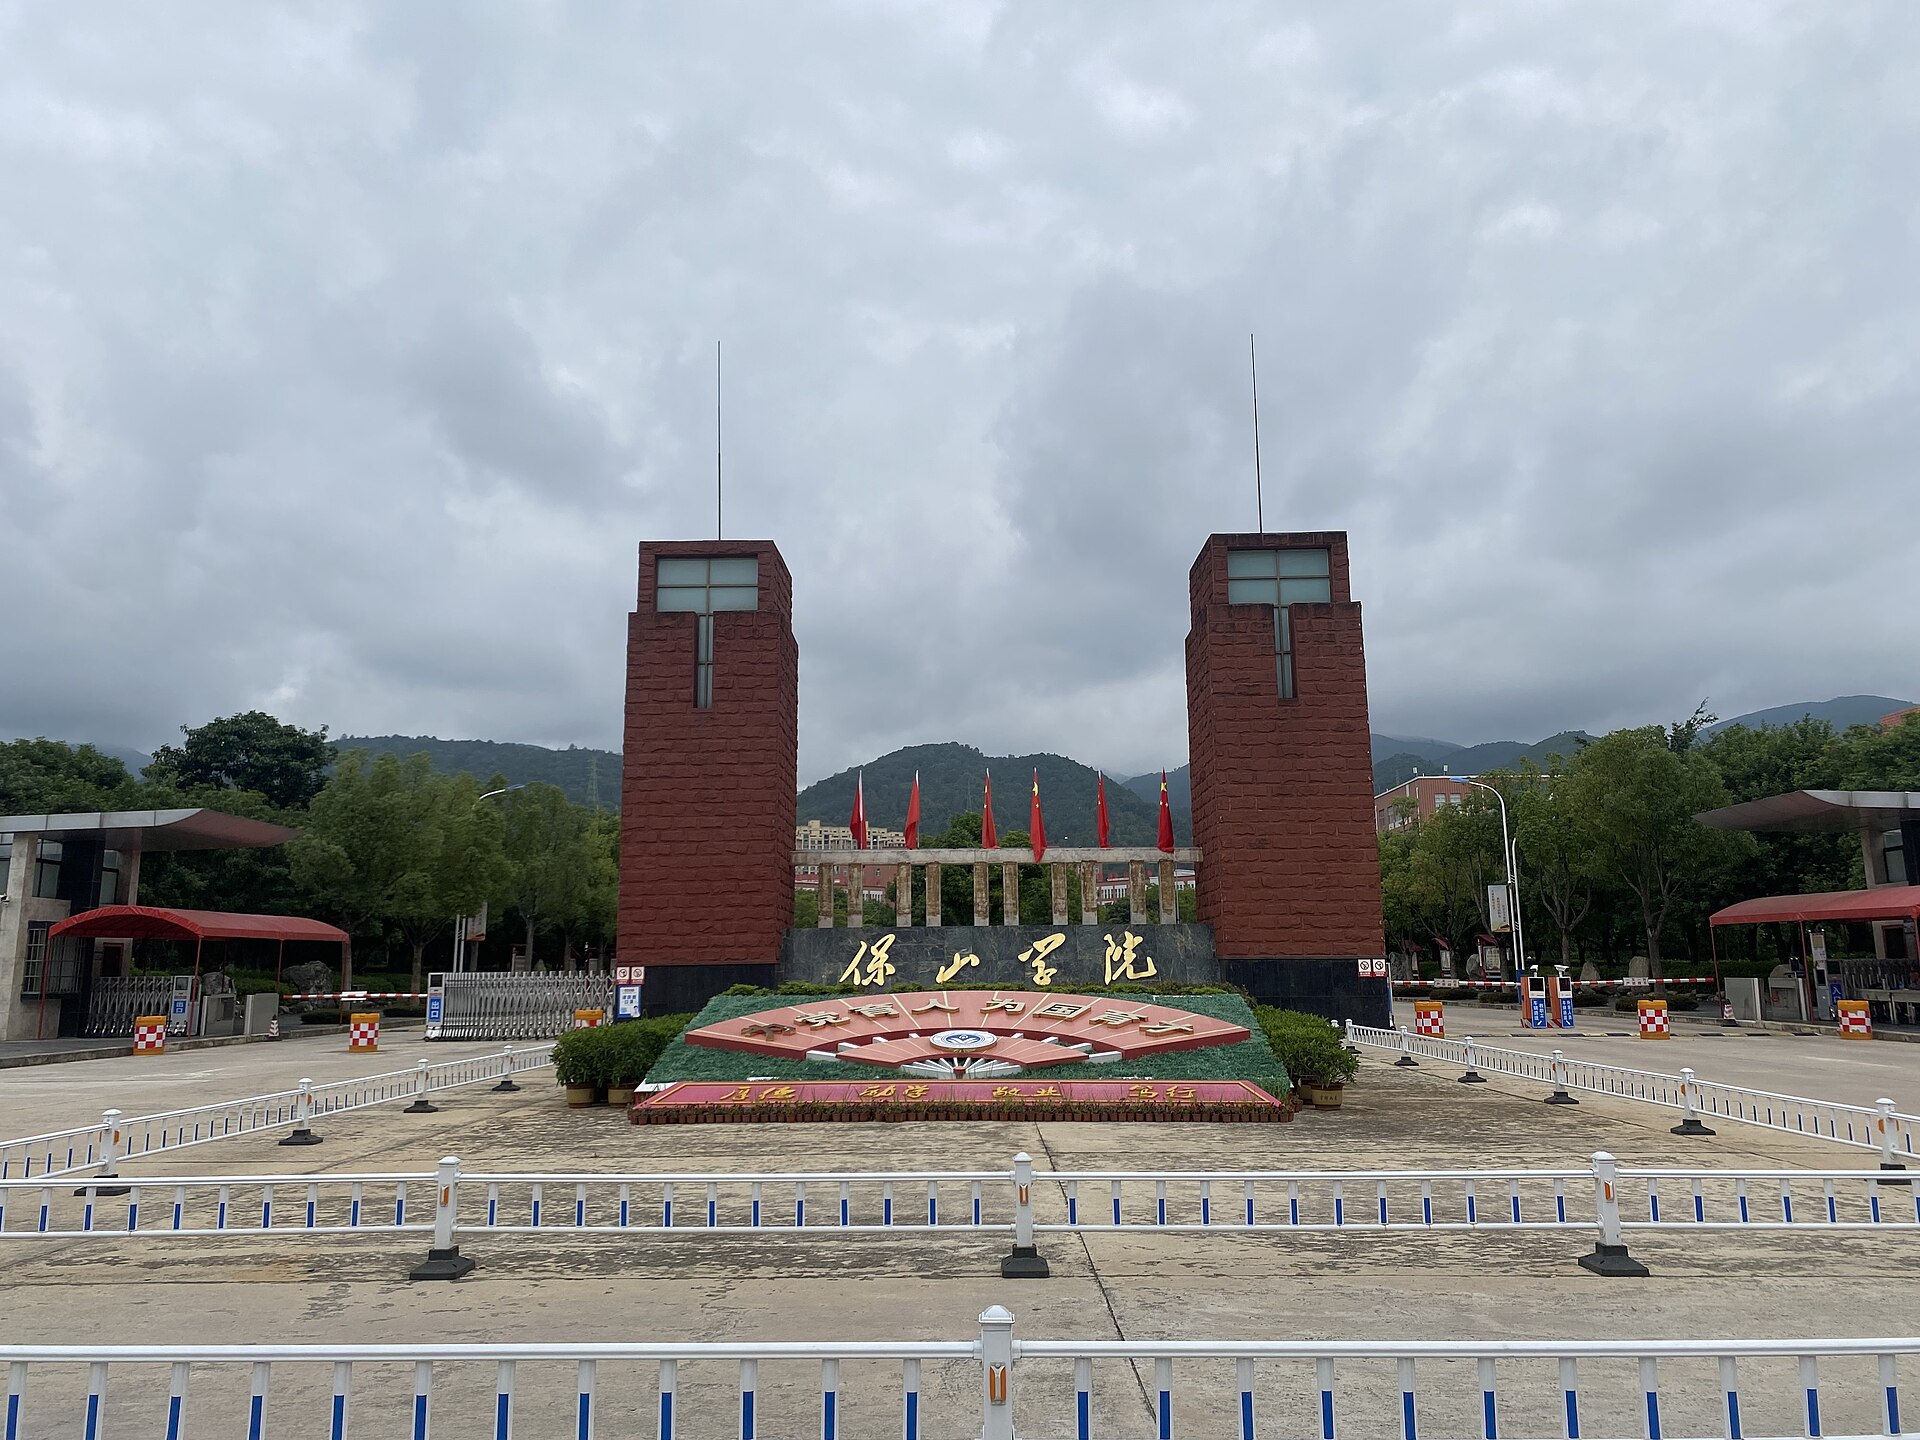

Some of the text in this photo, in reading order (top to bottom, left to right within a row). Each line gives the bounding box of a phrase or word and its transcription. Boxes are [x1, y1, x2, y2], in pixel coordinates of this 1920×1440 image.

[839, 931, 1157, 986] 保山学院
[431, 1001, 440, 1018] 出口
[992, 1086, 1062, 1097] 敬业
